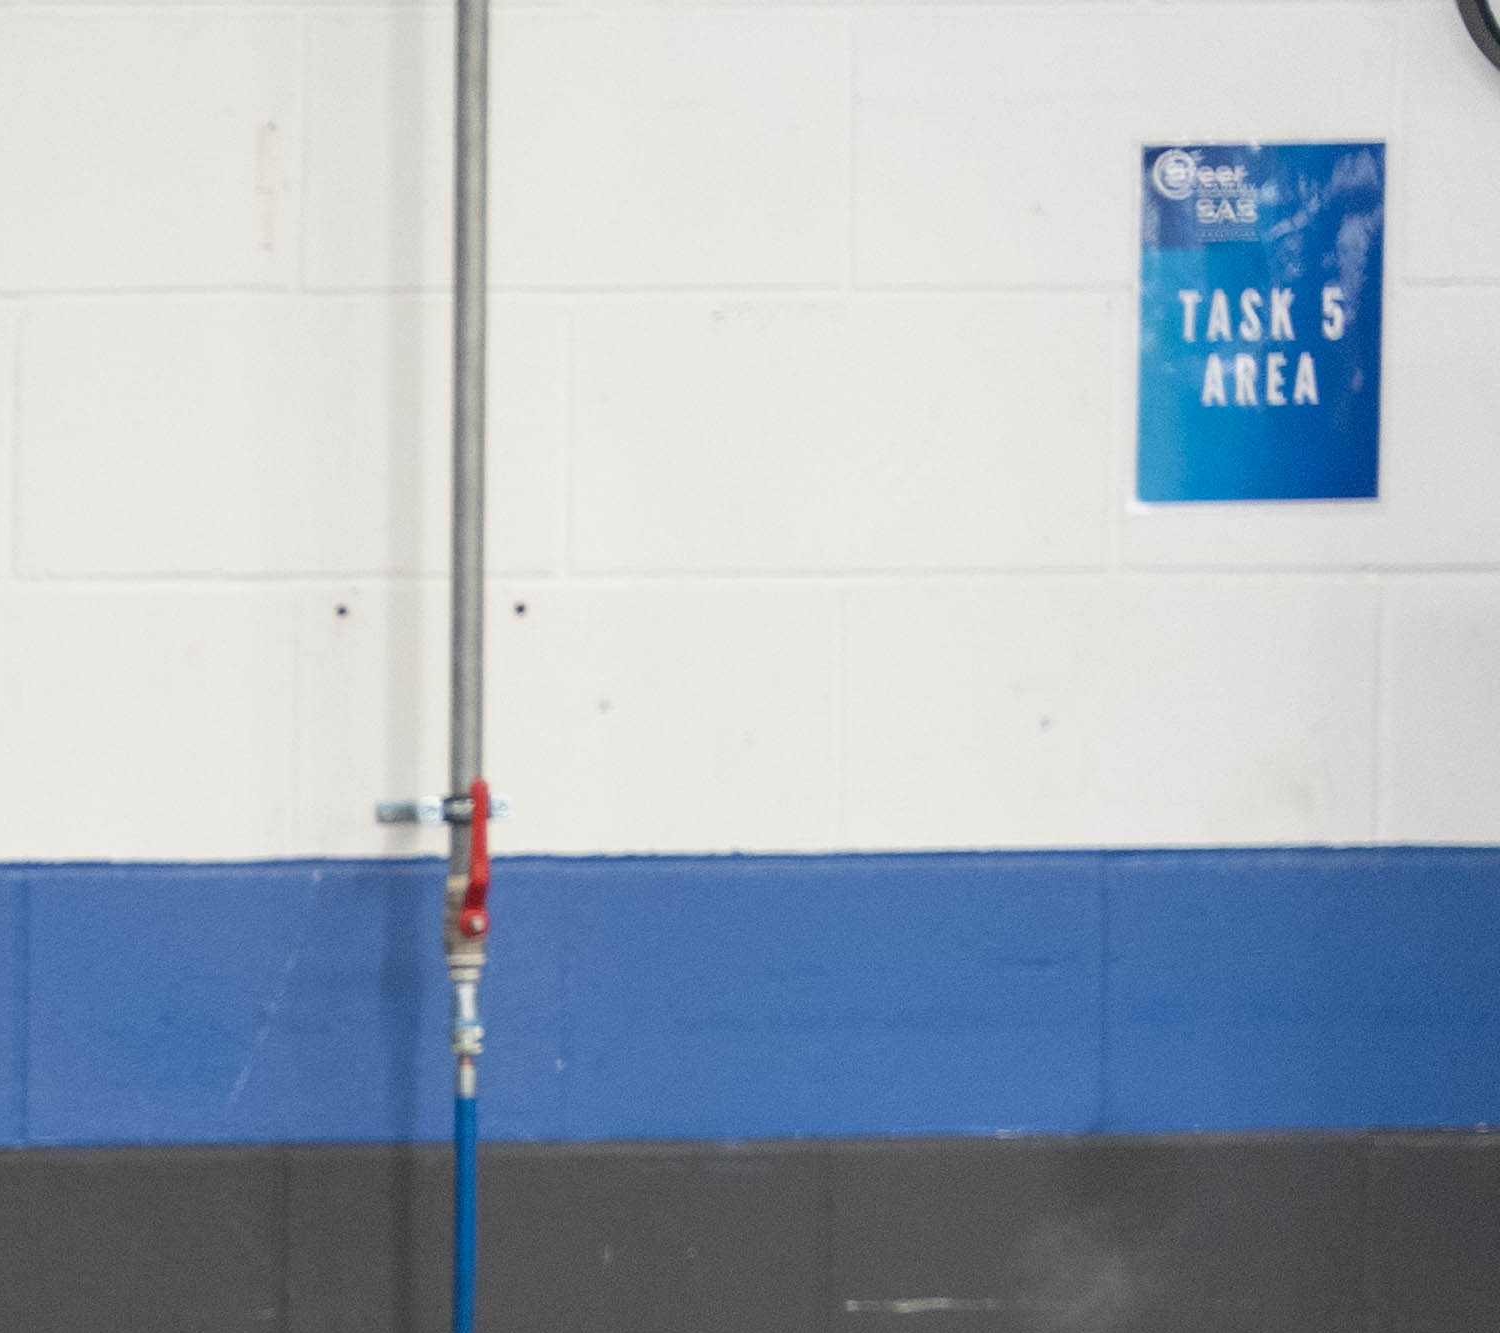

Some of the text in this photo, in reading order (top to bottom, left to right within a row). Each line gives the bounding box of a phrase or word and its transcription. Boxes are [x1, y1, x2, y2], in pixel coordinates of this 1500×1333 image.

[1195, 198, 1259, 224] SAS
[1177, 286, 1346, 343] TASK 5
[1200, 351, 1321, 407] AREA
